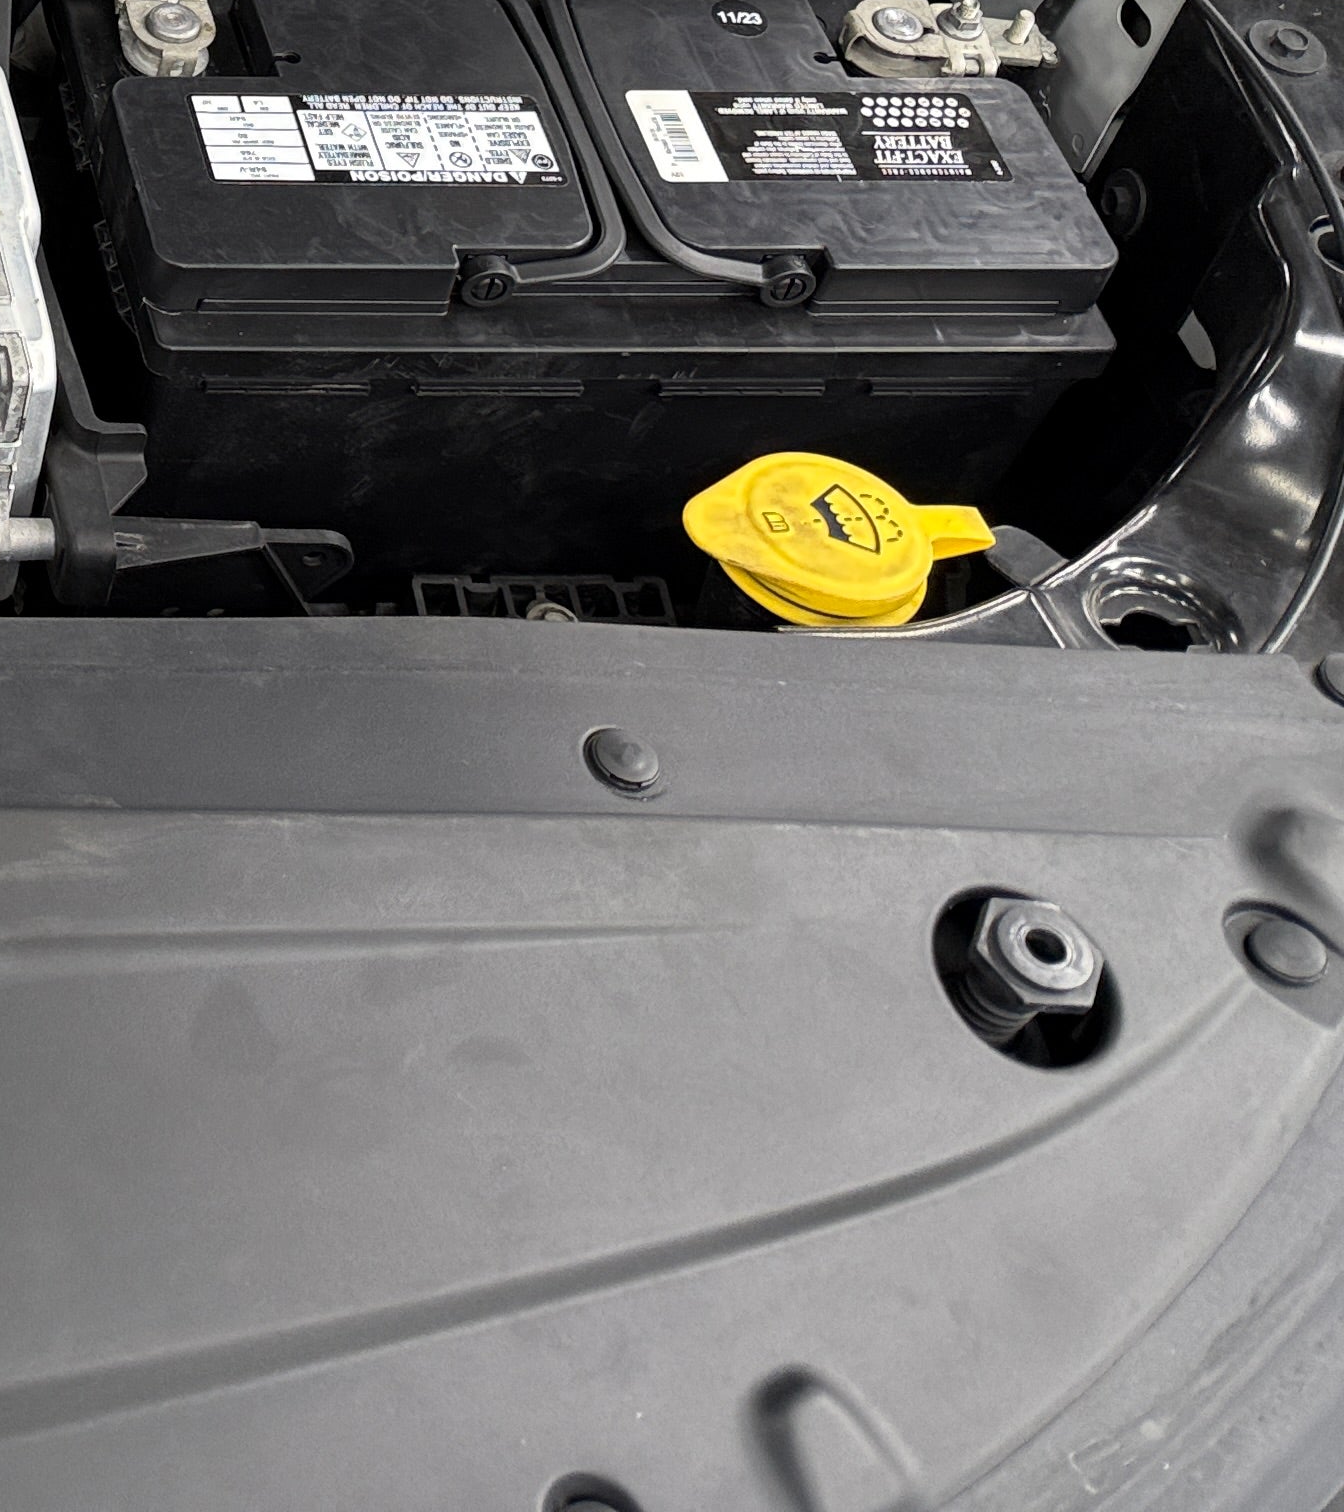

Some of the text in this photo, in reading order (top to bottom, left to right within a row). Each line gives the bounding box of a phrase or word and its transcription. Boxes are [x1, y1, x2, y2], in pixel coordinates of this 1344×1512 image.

[717, 10, 763, 25] 11/23
[874, 135, 953, 149] BATTERY
[874, 150, 964, 164] EXACT-FIT
[349, 170, 508, 183] DANGER/POISON
